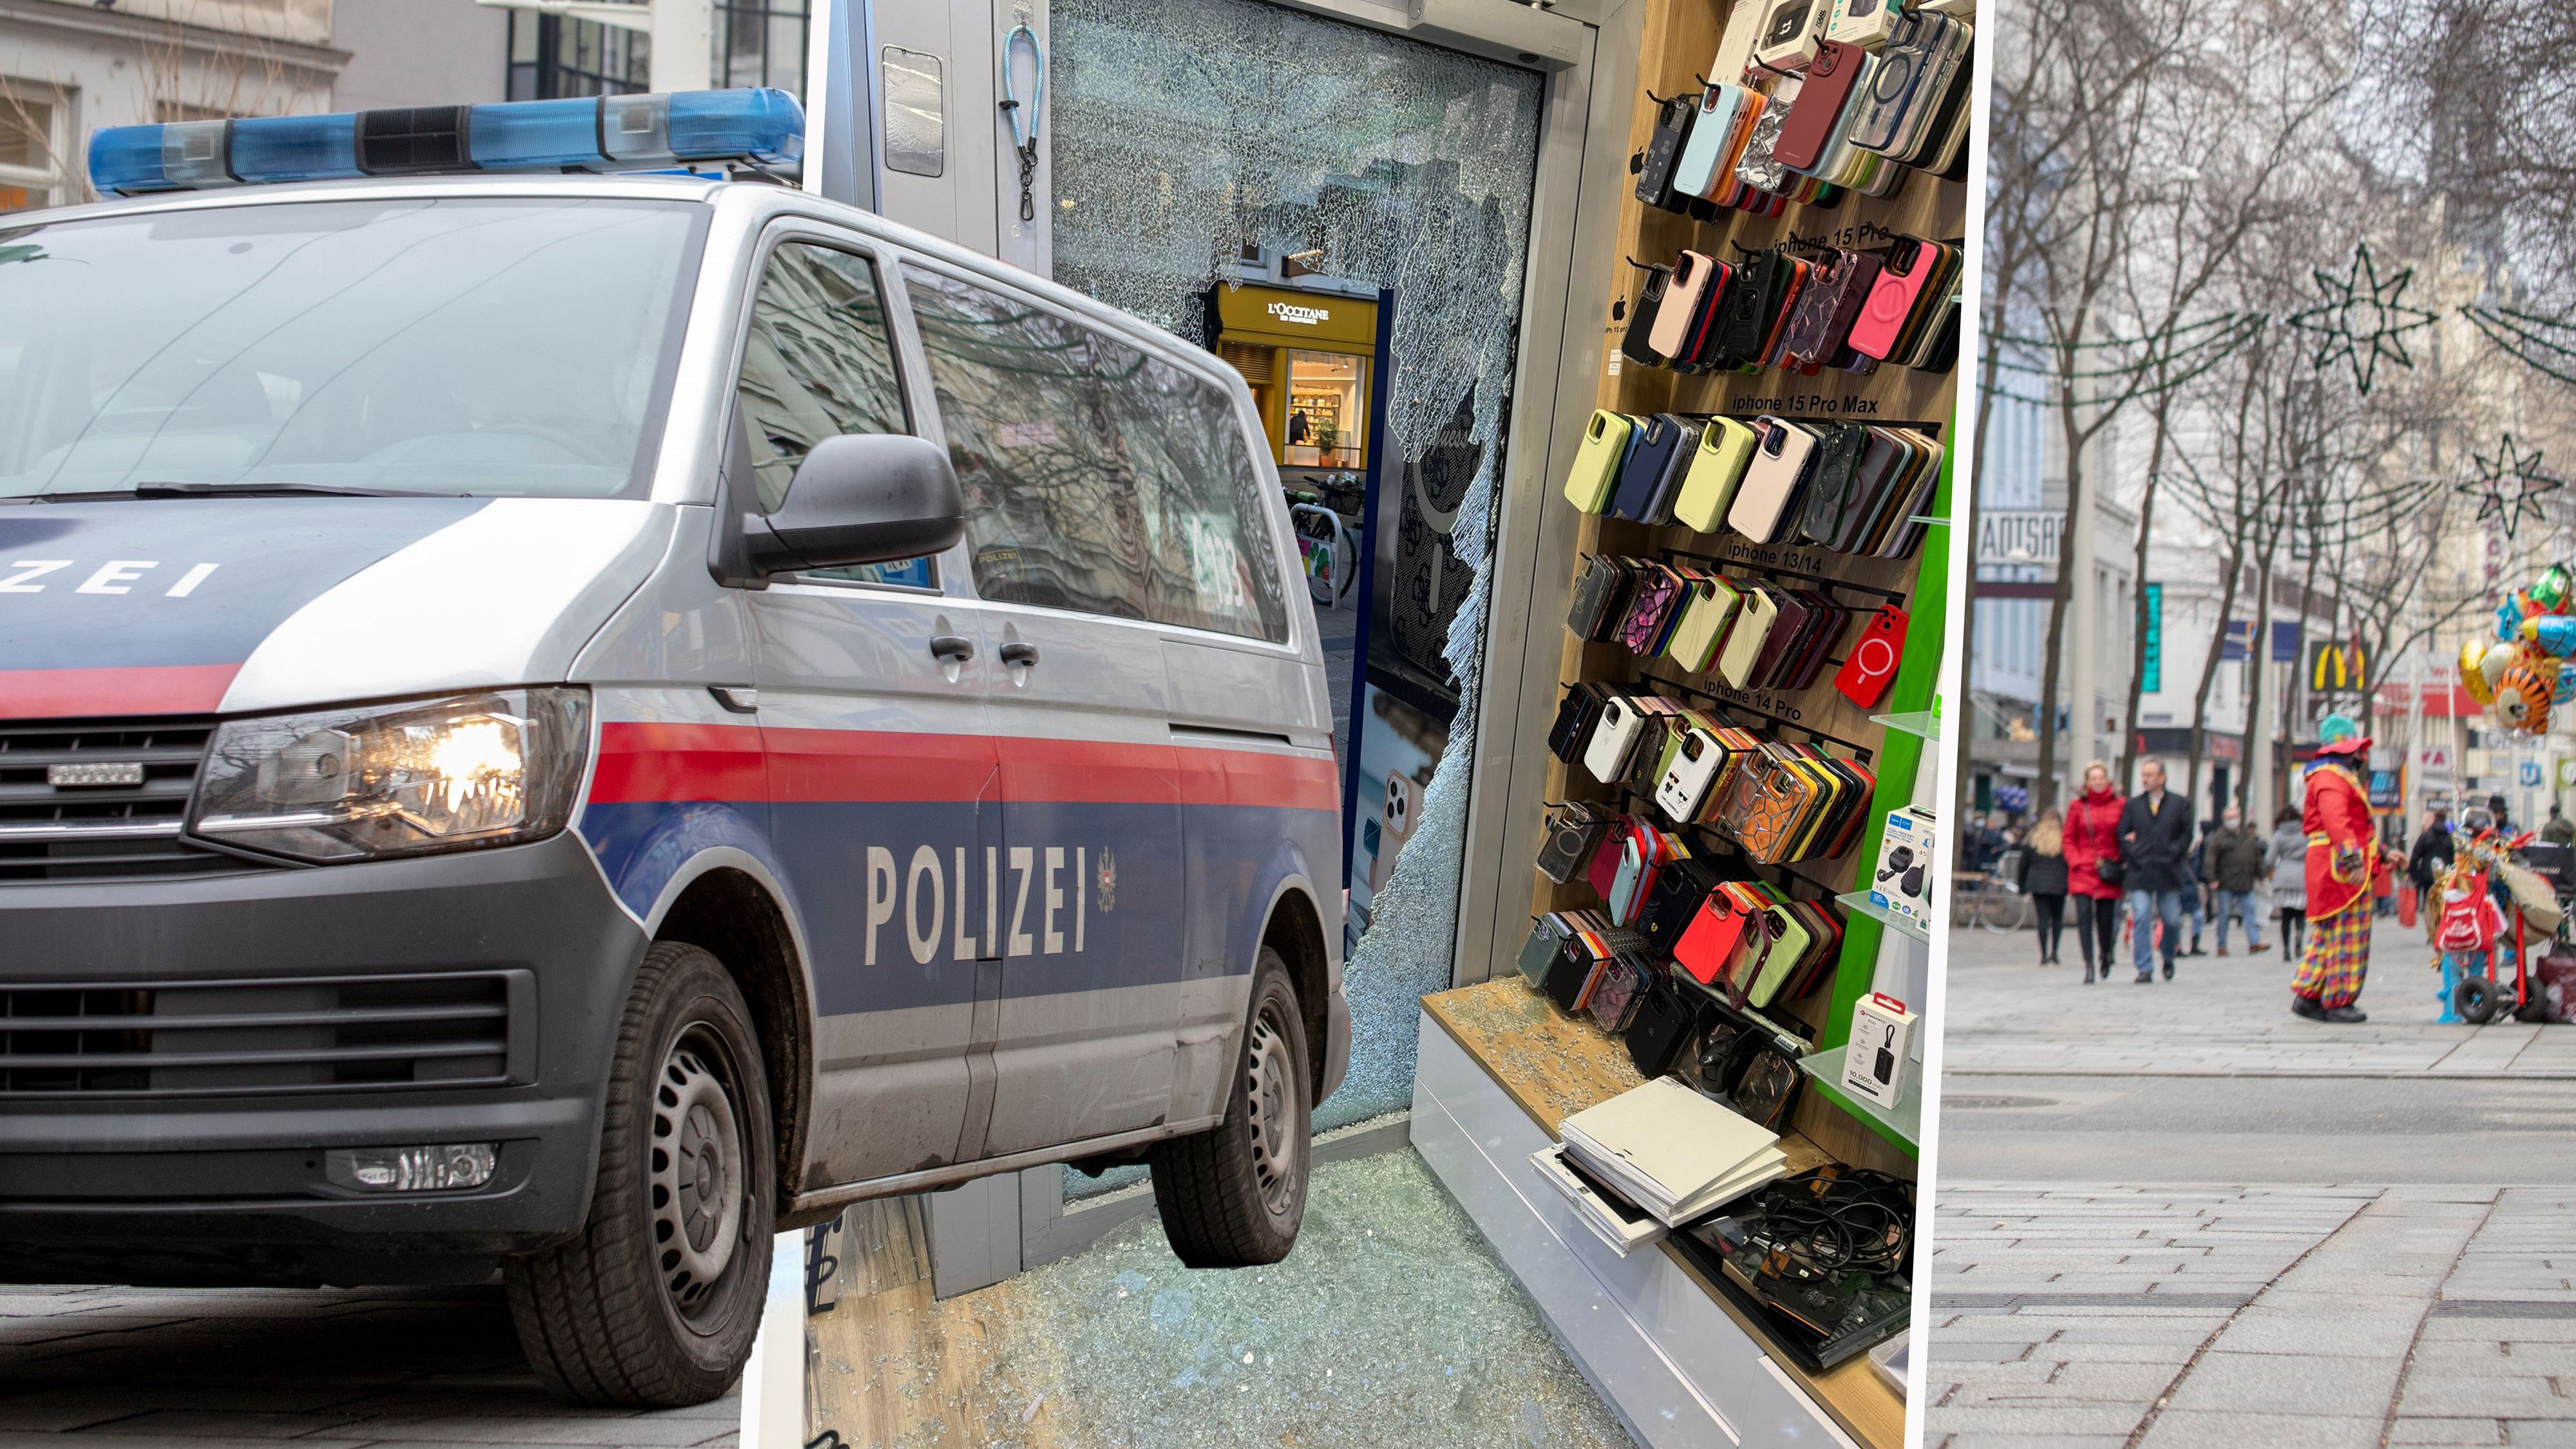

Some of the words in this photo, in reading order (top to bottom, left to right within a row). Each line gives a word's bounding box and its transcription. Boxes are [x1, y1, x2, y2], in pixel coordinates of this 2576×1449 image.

[1833, 227, 1853, 246] 15
[1857, 225, 1889, 243] Pro
[1732, 394, 1782, 412] iphone
[1788, 395, 1804, 411] 15
[1809, 395, 1837, 412] Pro
[1842, 396, 1879, 413] Max
[1728, 541, 1777, 564] iphone
[1783, 551, 1821, 573] 13/14
[0, 560, 221, 598] ZEI
[1704, 677, 1750, 703] iphone
[1756, 694, 1771, 710] 14
[1775, 699, 1801, 720] Pro
[2522, 766, 2537, 784] U
[865, 844, 1086, 965] POLIZEI
